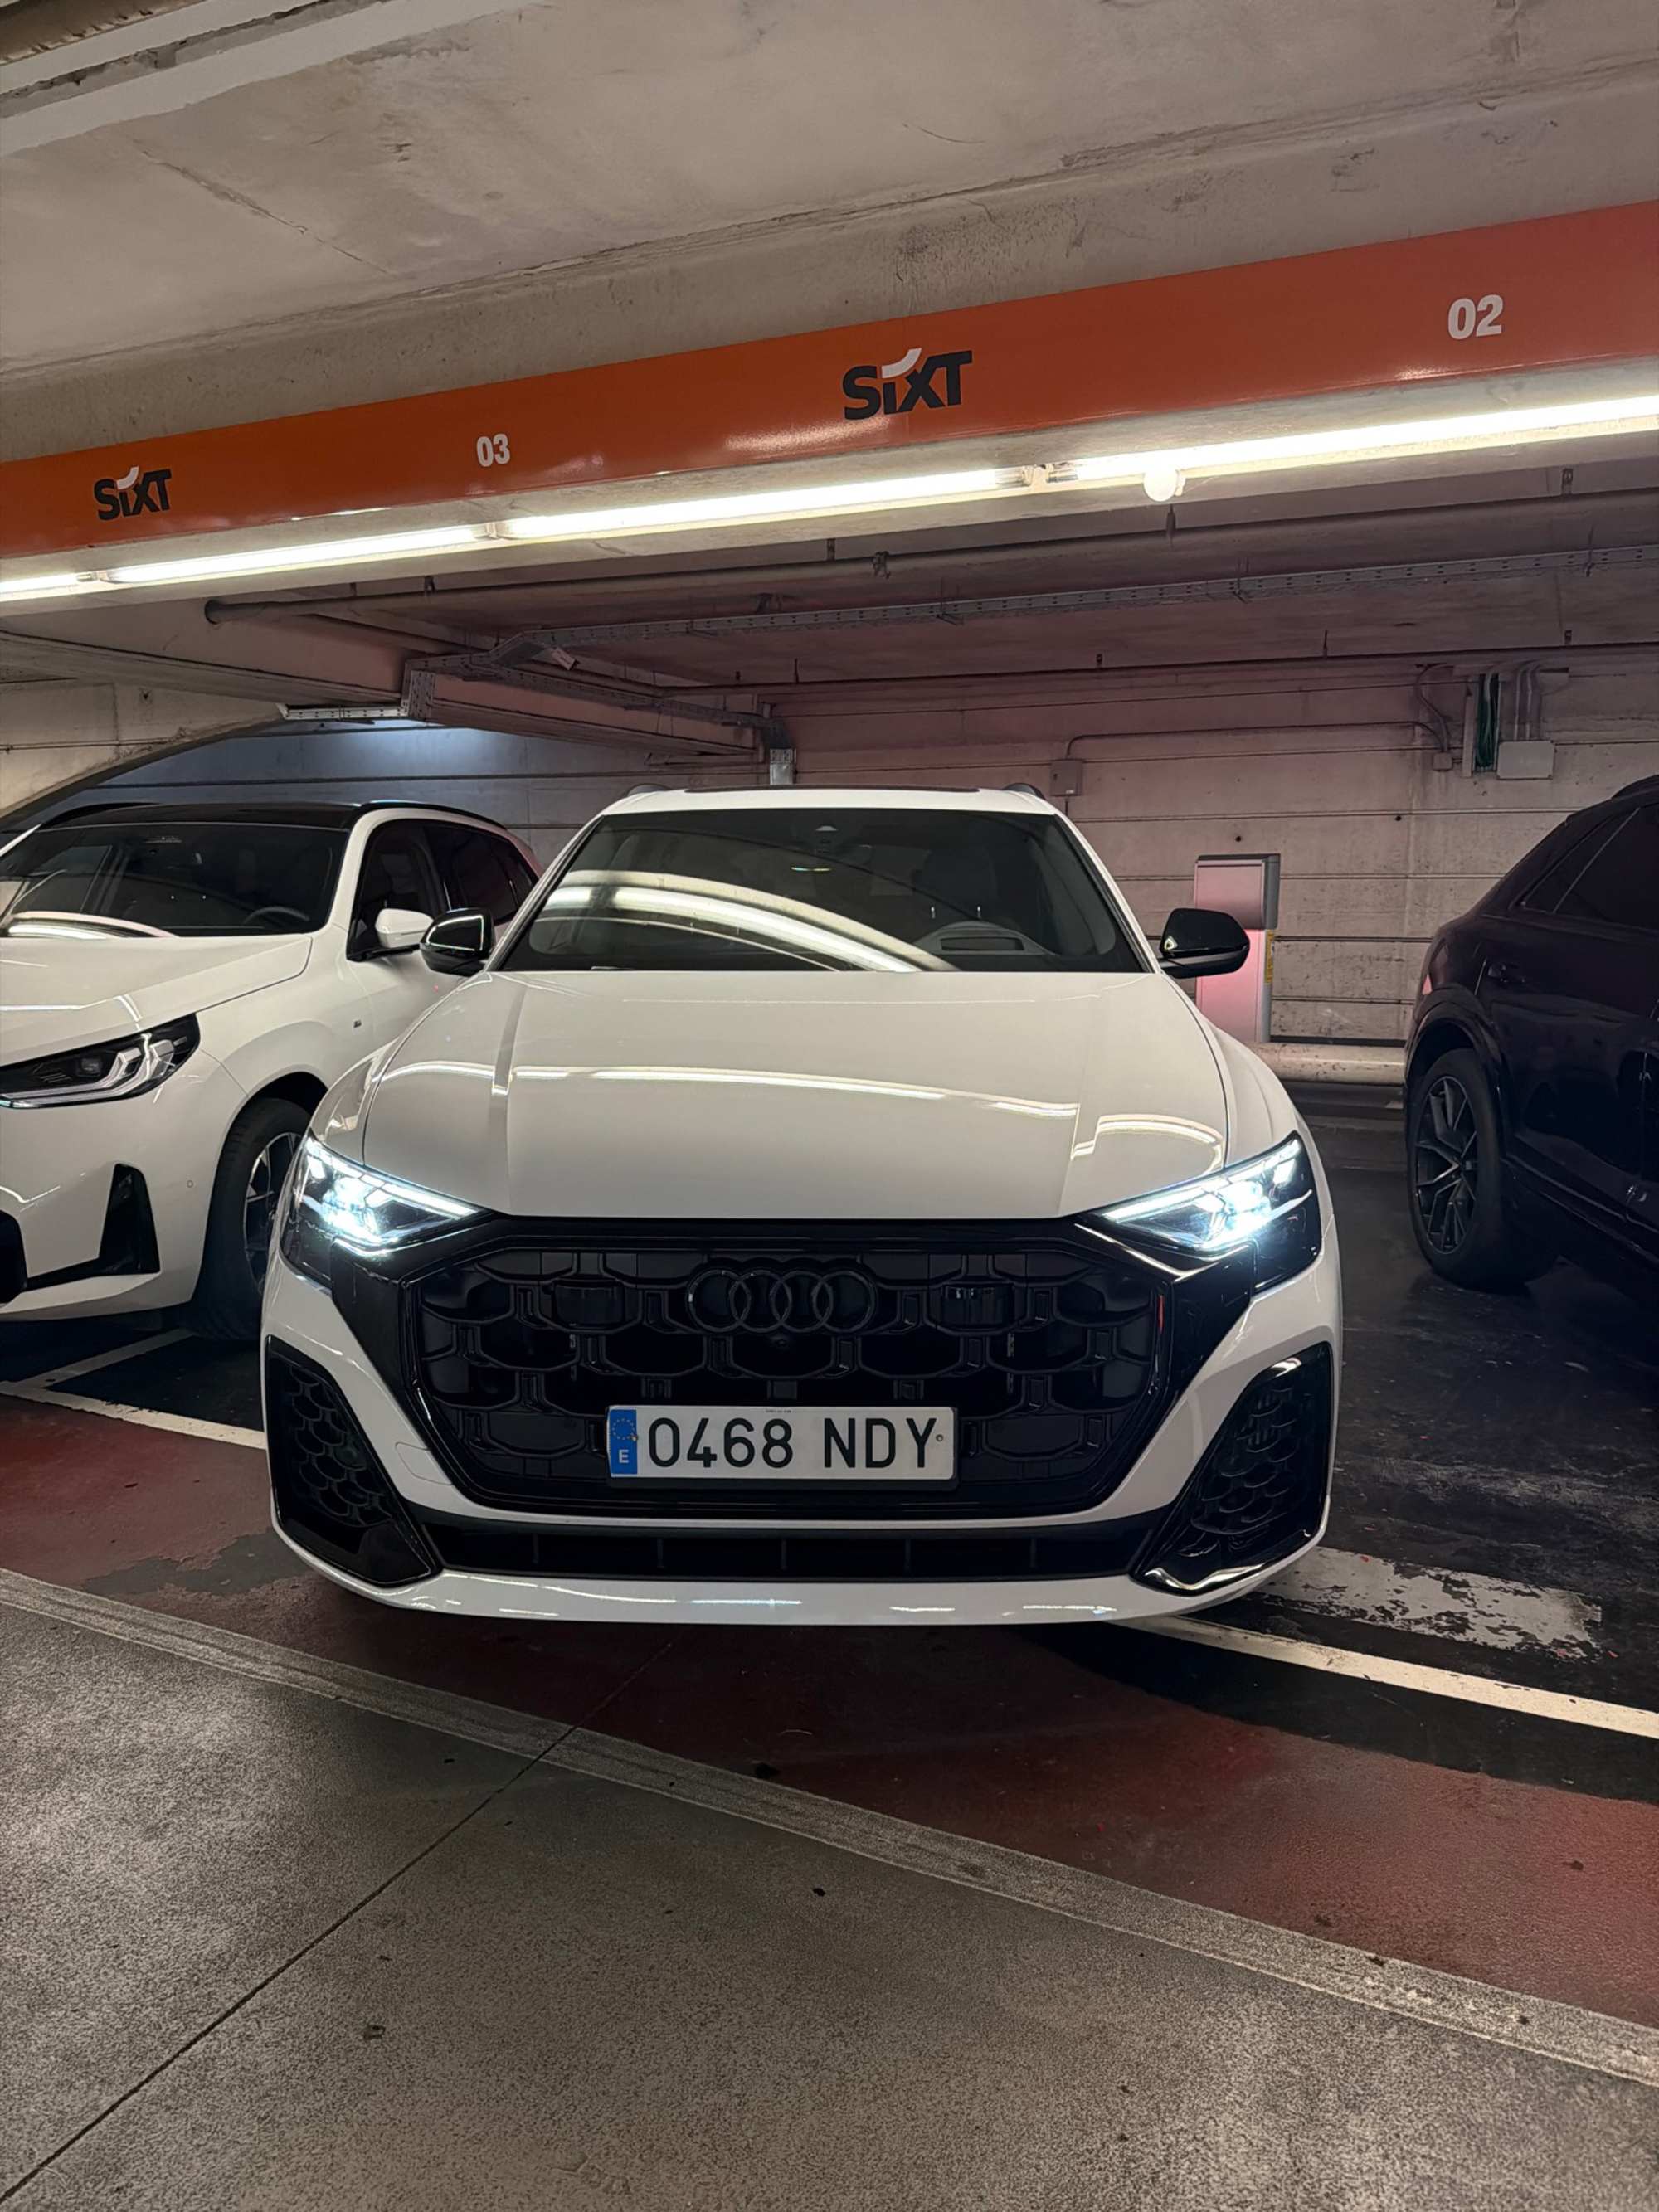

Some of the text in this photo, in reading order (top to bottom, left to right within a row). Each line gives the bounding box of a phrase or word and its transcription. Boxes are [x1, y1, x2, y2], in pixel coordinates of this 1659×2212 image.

[1447, 294, 1504, 340] 02
[476, 433, 511, 468] 03
[618, 1449, 629, 1464] E
[648, 1417, 938, 1469] 0468 NDY
